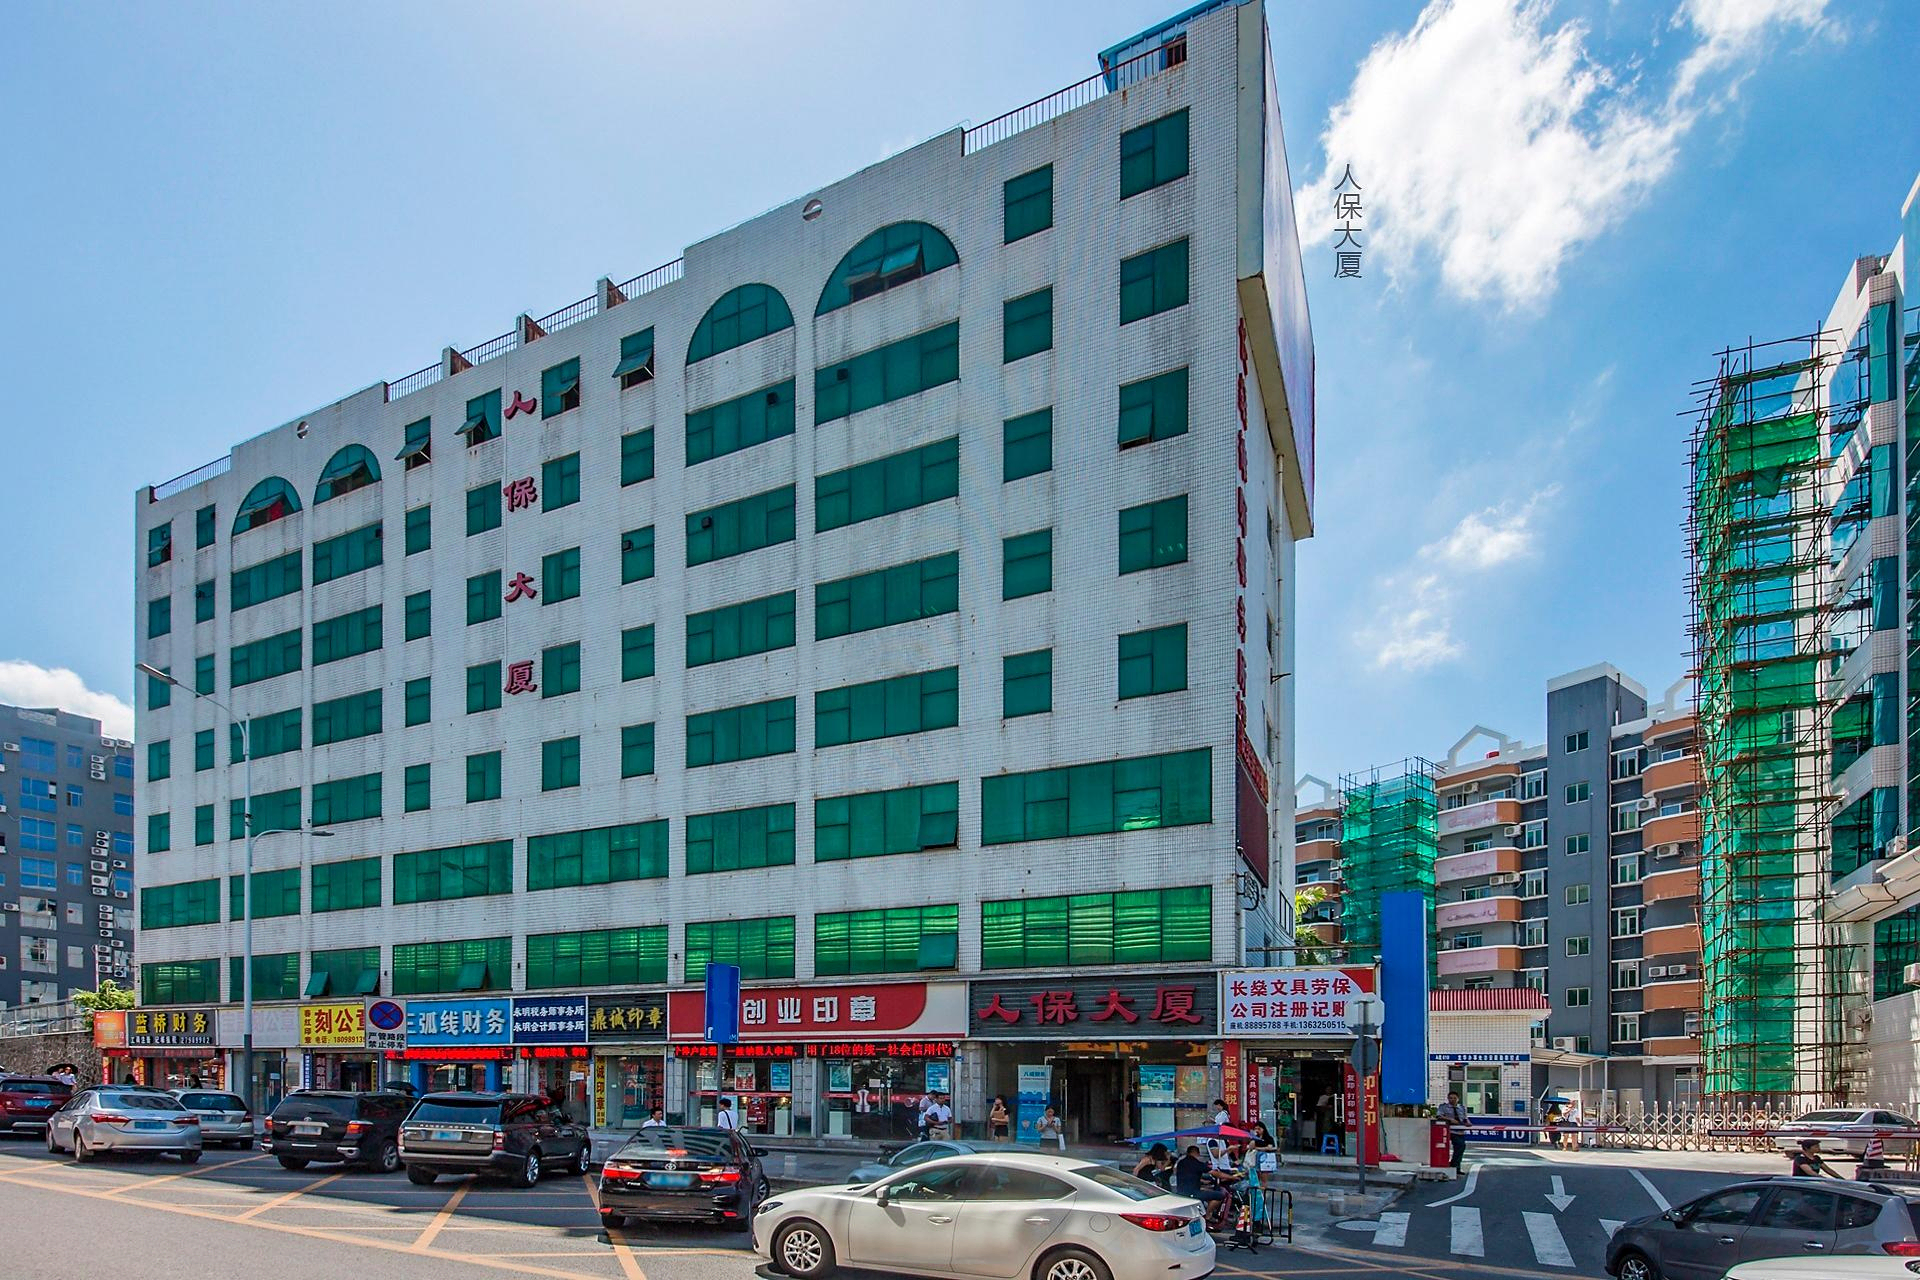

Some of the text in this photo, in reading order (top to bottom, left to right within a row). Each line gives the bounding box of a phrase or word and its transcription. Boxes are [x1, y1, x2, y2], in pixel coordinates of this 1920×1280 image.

[503, 390, 537, 695] 人保大厦
[513, 1006, 585, 1017] 永明税务师事务所
[742, 995, 876, 1024] 创业印章
[977, 985, 1203, 1025] 人保大厦
[135, 1012, 207, 1034] 蓝桥财务
[513, 1021, 585, 1032] 永明会计师事务所
[591, 1007, 664, 1031] 鼎诚印章
[1283, 1020, 1350, 1030] 手机:1363250515
[368, 1031, 405, 1041] 严管路段
[368, 1040, 404, 1048] 禁止停车
[807, 1043, 952, 1056] 用了18位的统一社会信用代
[1225, 1056, 1238, 1105] 记账报税
